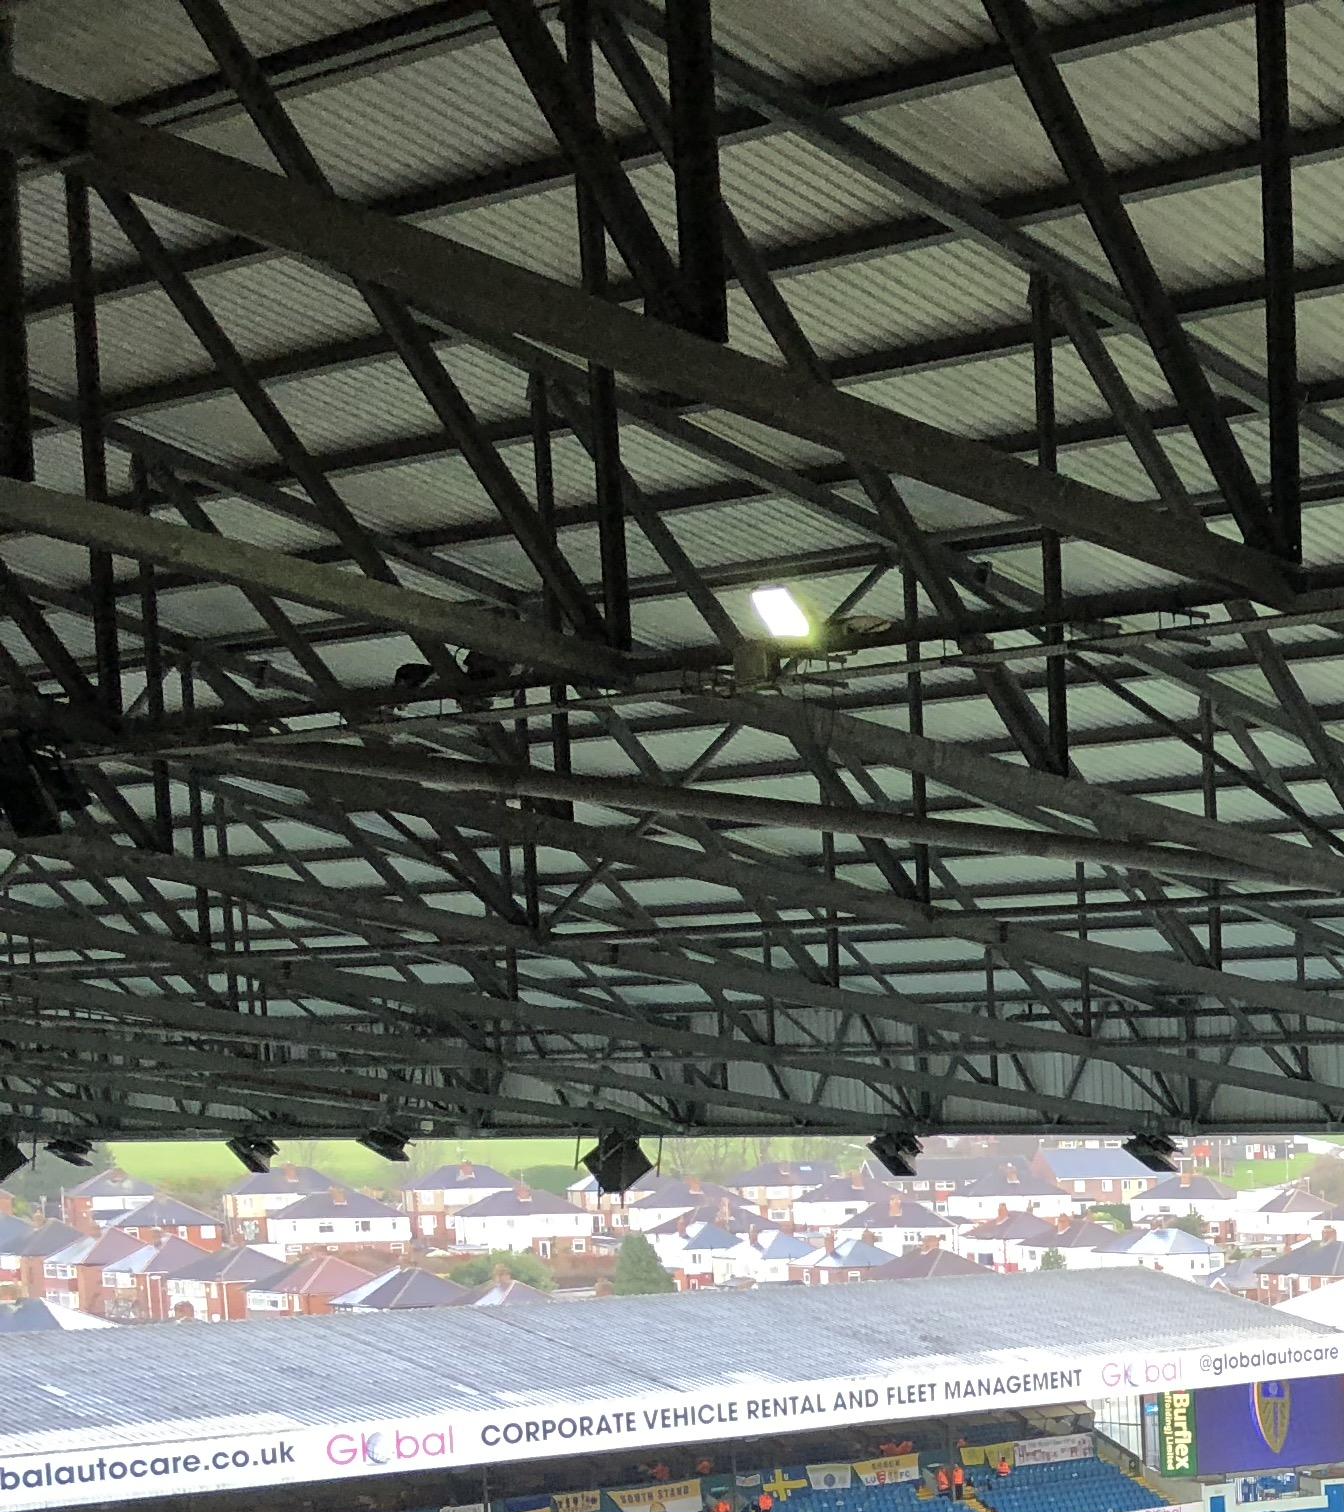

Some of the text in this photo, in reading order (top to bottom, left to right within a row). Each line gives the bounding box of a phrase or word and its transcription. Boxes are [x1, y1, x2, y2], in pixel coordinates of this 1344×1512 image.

[1199, 1345, 1339, 1375] @globalautocare
[481, 1369, 1083, 1447] CORPORATE VEHICLE RENTAL AND FLEET MANAGEMENT
[1173, 1393, 1192, 1470] Burflex
[0, 1441, 296, 1490] balautocare.co.uk
[1166, 1436, 1175, 1470] Limited
